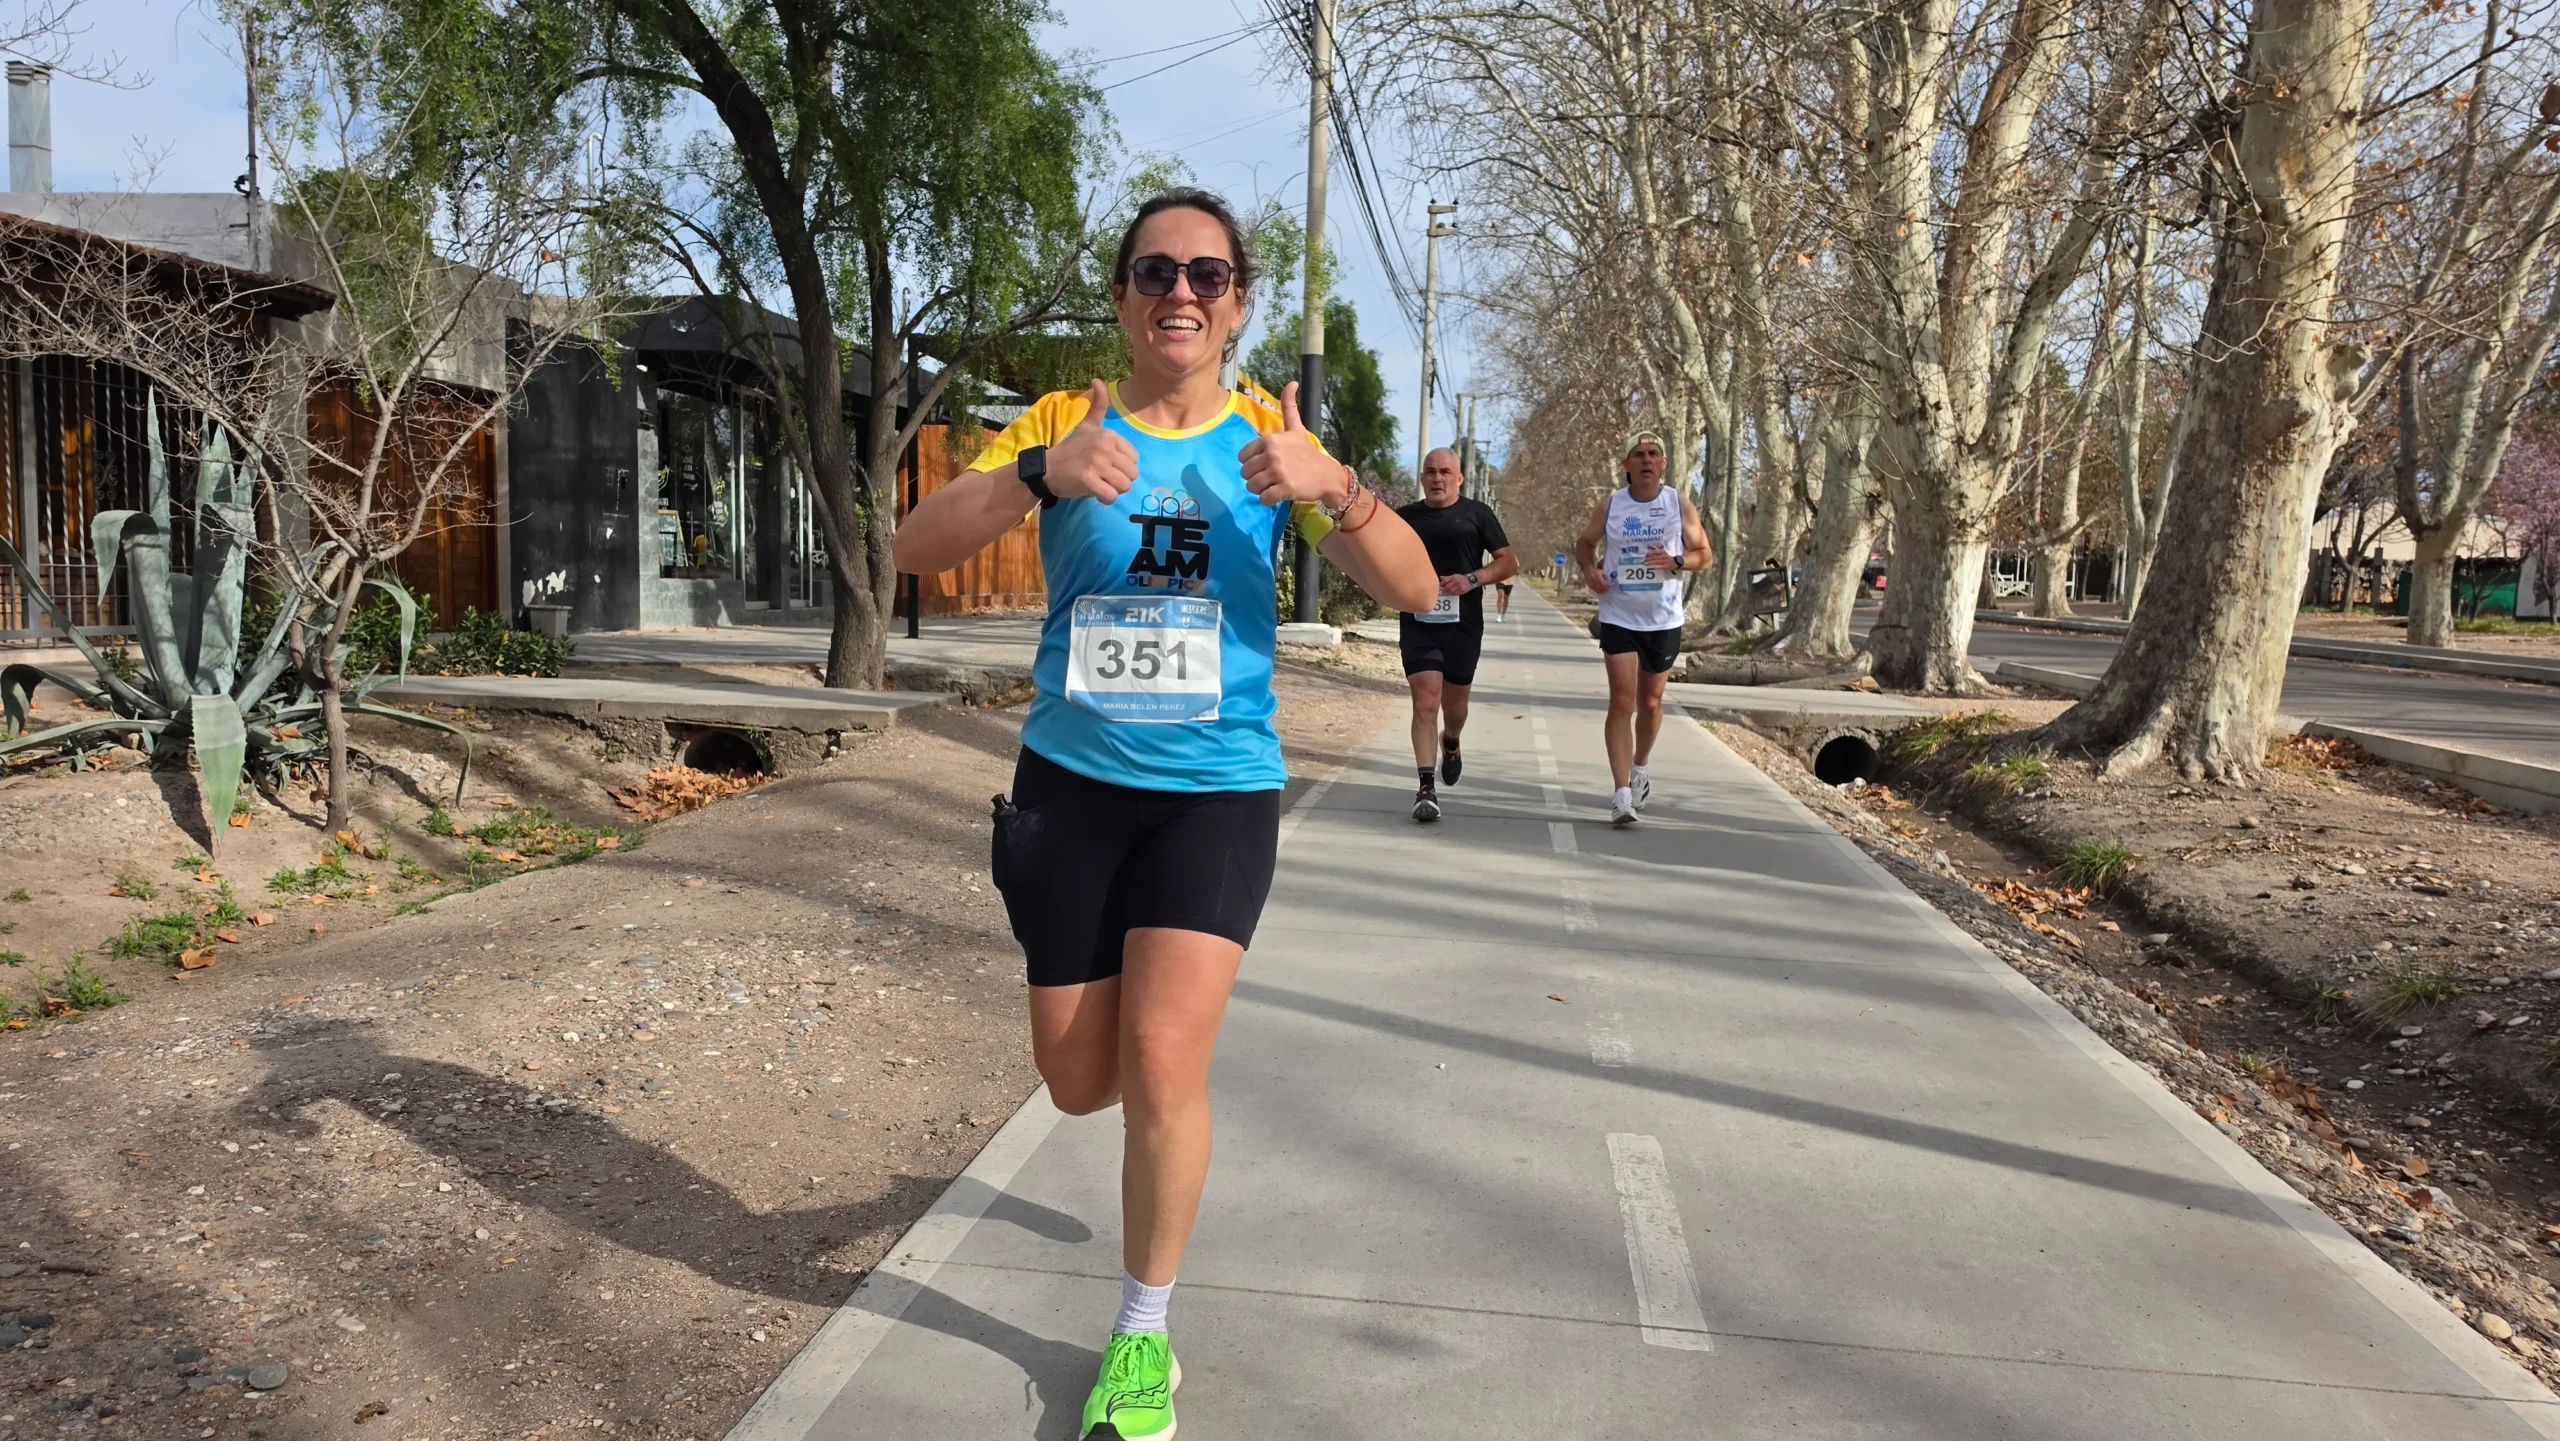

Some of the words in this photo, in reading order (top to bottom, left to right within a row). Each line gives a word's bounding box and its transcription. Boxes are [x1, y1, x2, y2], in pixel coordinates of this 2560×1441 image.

[1623, 526, 1665, 537] MARATON
[1625, 568, 1656, 580] 205
[1433, 599, 1451, 611] 68
[1124, 606, 1164, 623] 21K
[1096, 640, 1188, 681] 351
[1159, 703, 1186, 711] PEREZ
